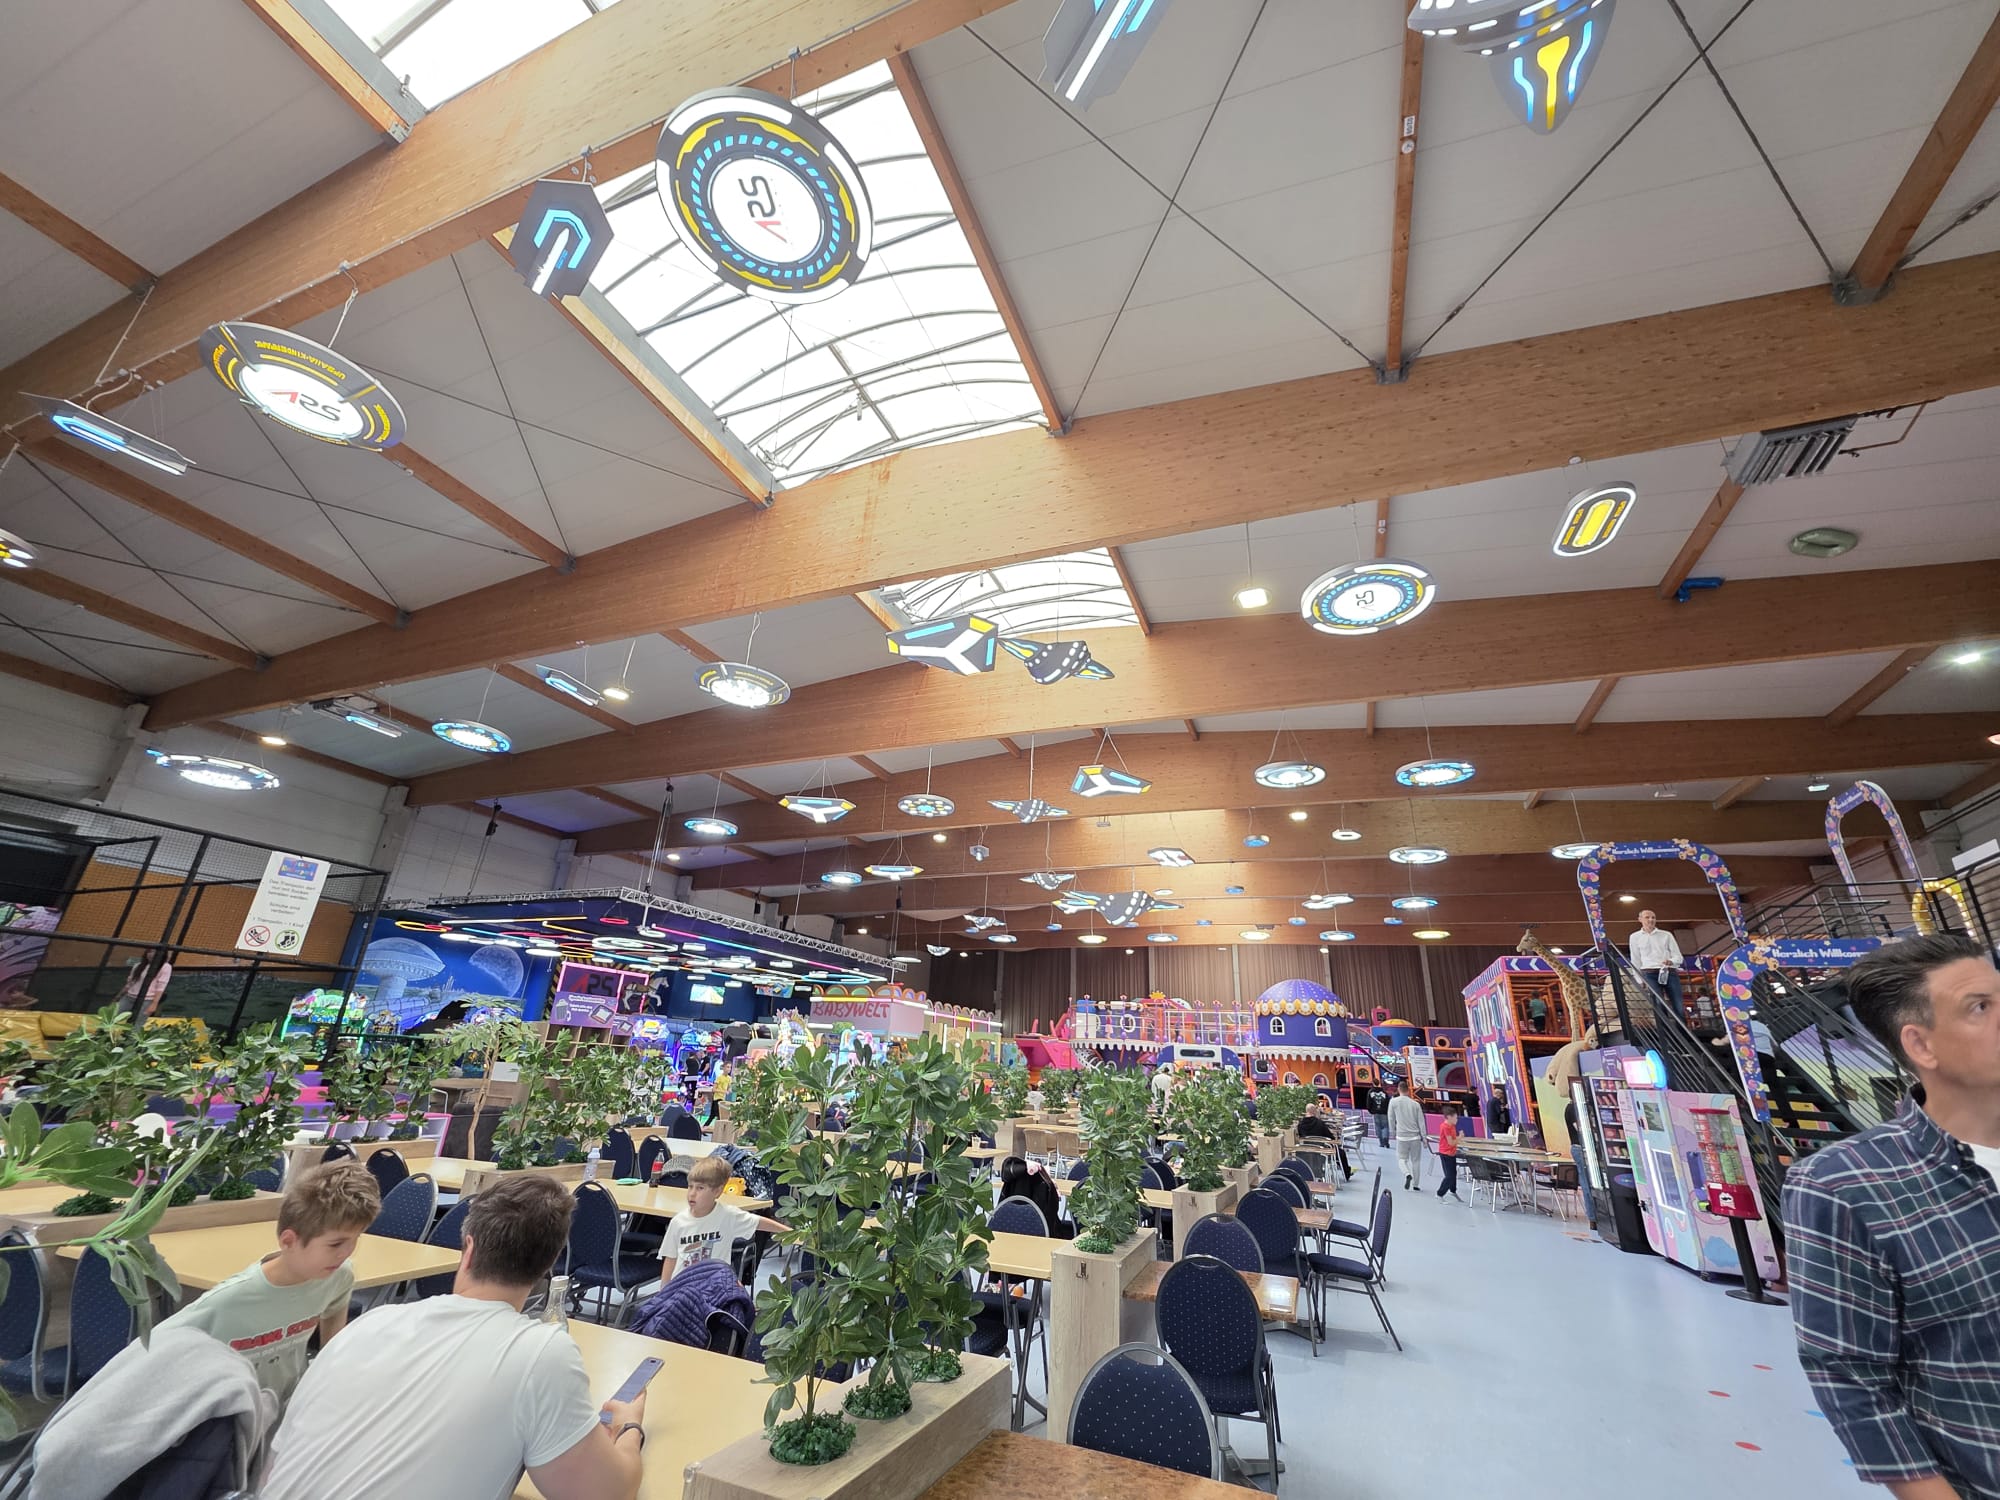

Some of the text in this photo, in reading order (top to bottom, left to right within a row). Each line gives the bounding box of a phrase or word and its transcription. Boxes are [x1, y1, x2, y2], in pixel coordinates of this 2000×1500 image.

[1771, 948, 1818, 958] Herzlich
[813, 1001, 891, 1018] BABYWELT
[680, 1231, 722, 1245] MARVEL
